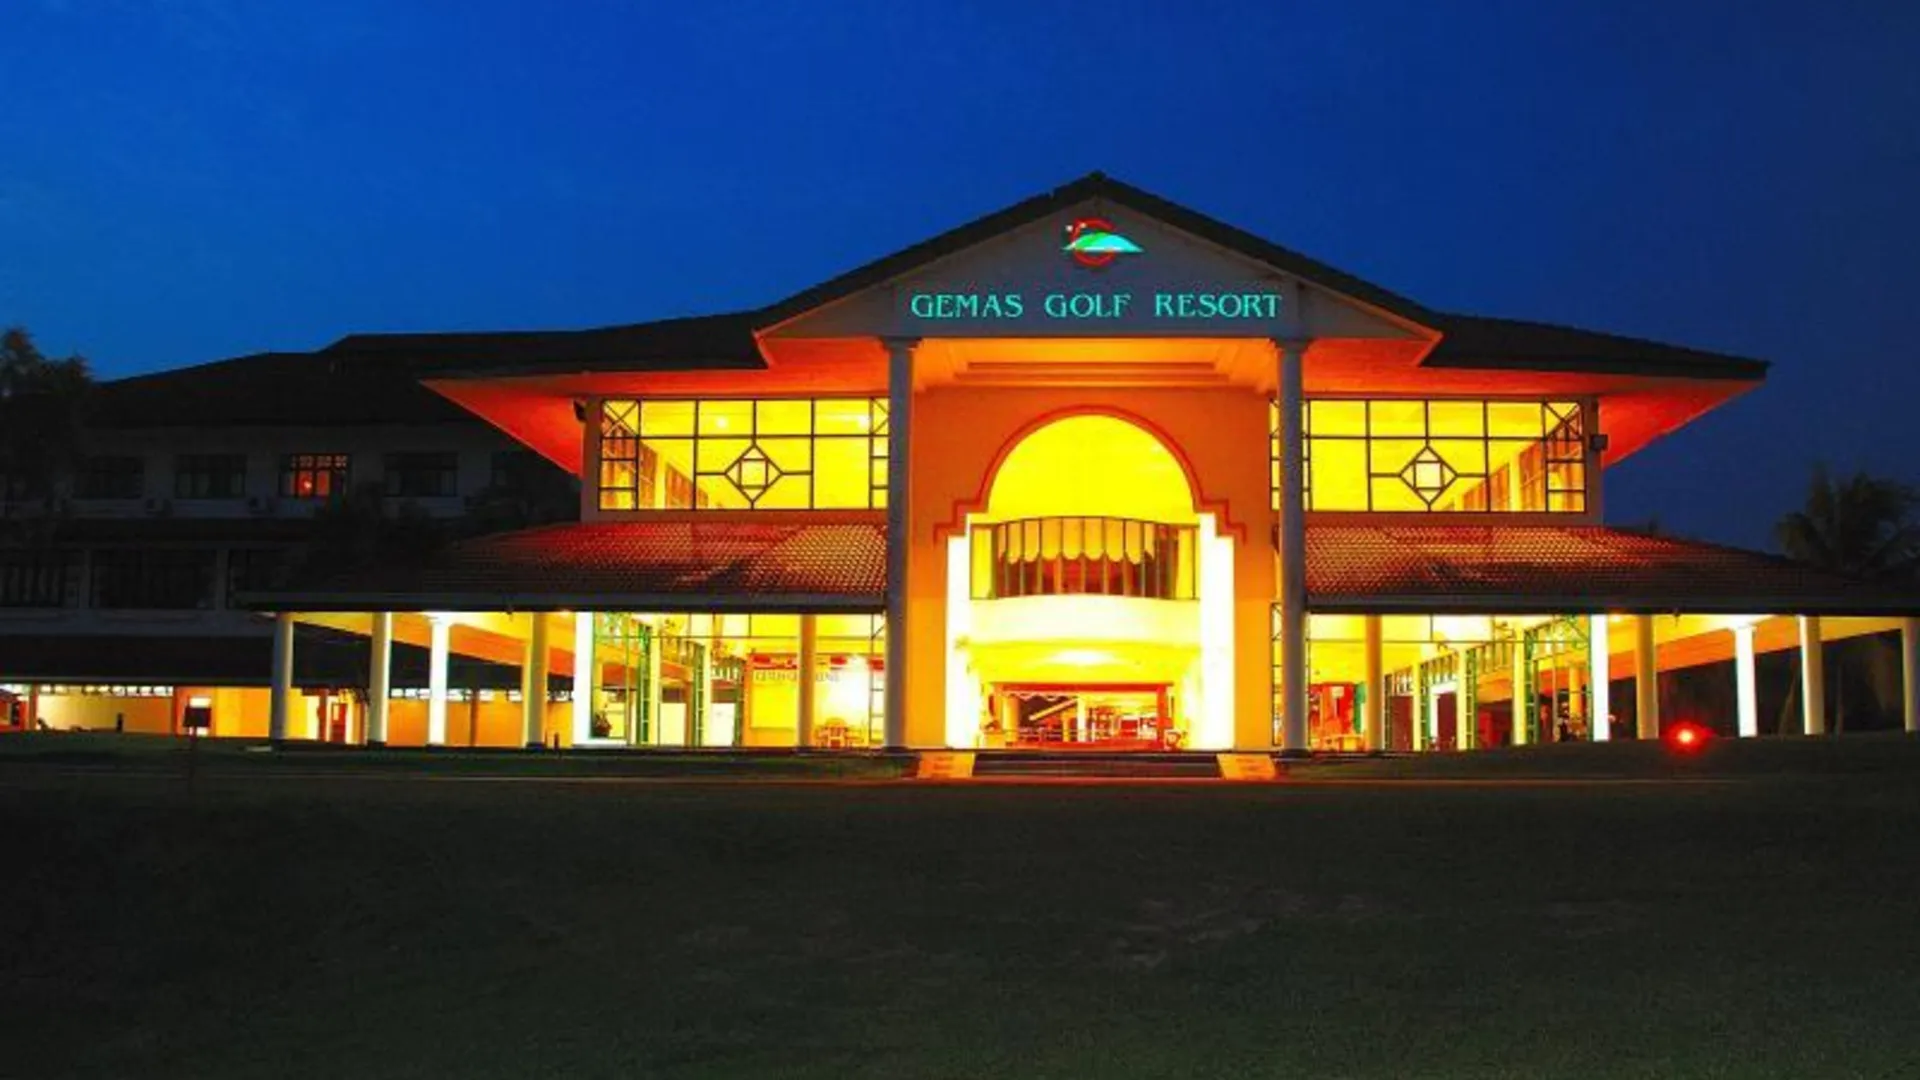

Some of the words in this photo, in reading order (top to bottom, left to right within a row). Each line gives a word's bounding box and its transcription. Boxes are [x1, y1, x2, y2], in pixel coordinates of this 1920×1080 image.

[911, 294, 1024, 318] GEMAS
[1044, 293, 1131, 318] GOLF
[1155, 293, 1282, 318] RESORT
